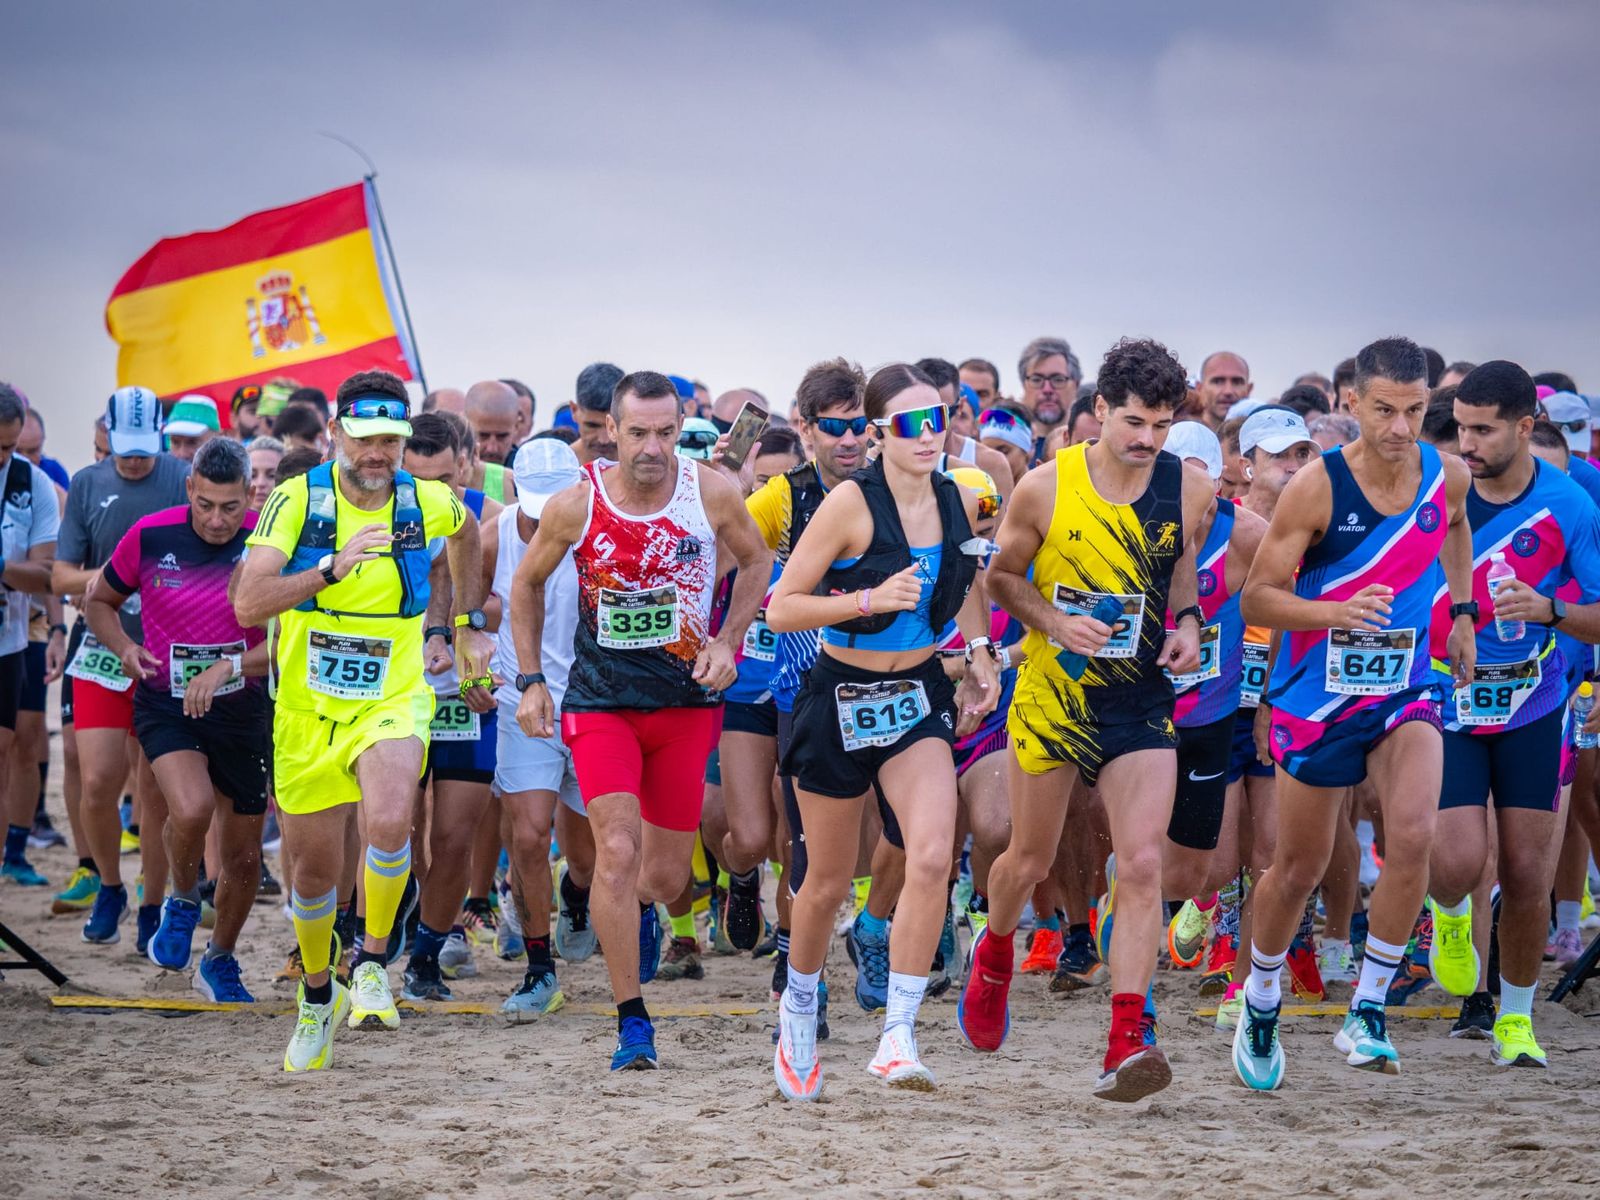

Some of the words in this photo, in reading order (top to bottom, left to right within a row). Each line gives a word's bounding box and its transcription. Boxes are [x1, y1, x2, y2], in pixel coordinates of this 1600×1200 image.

[612, 609, 672, 633] 339
[321, 655, 381, 683] 759
[1344, 654, 1405, 677] 647
[435, 705, 471, 725] 49
[855, 696, 920, 730] 613
